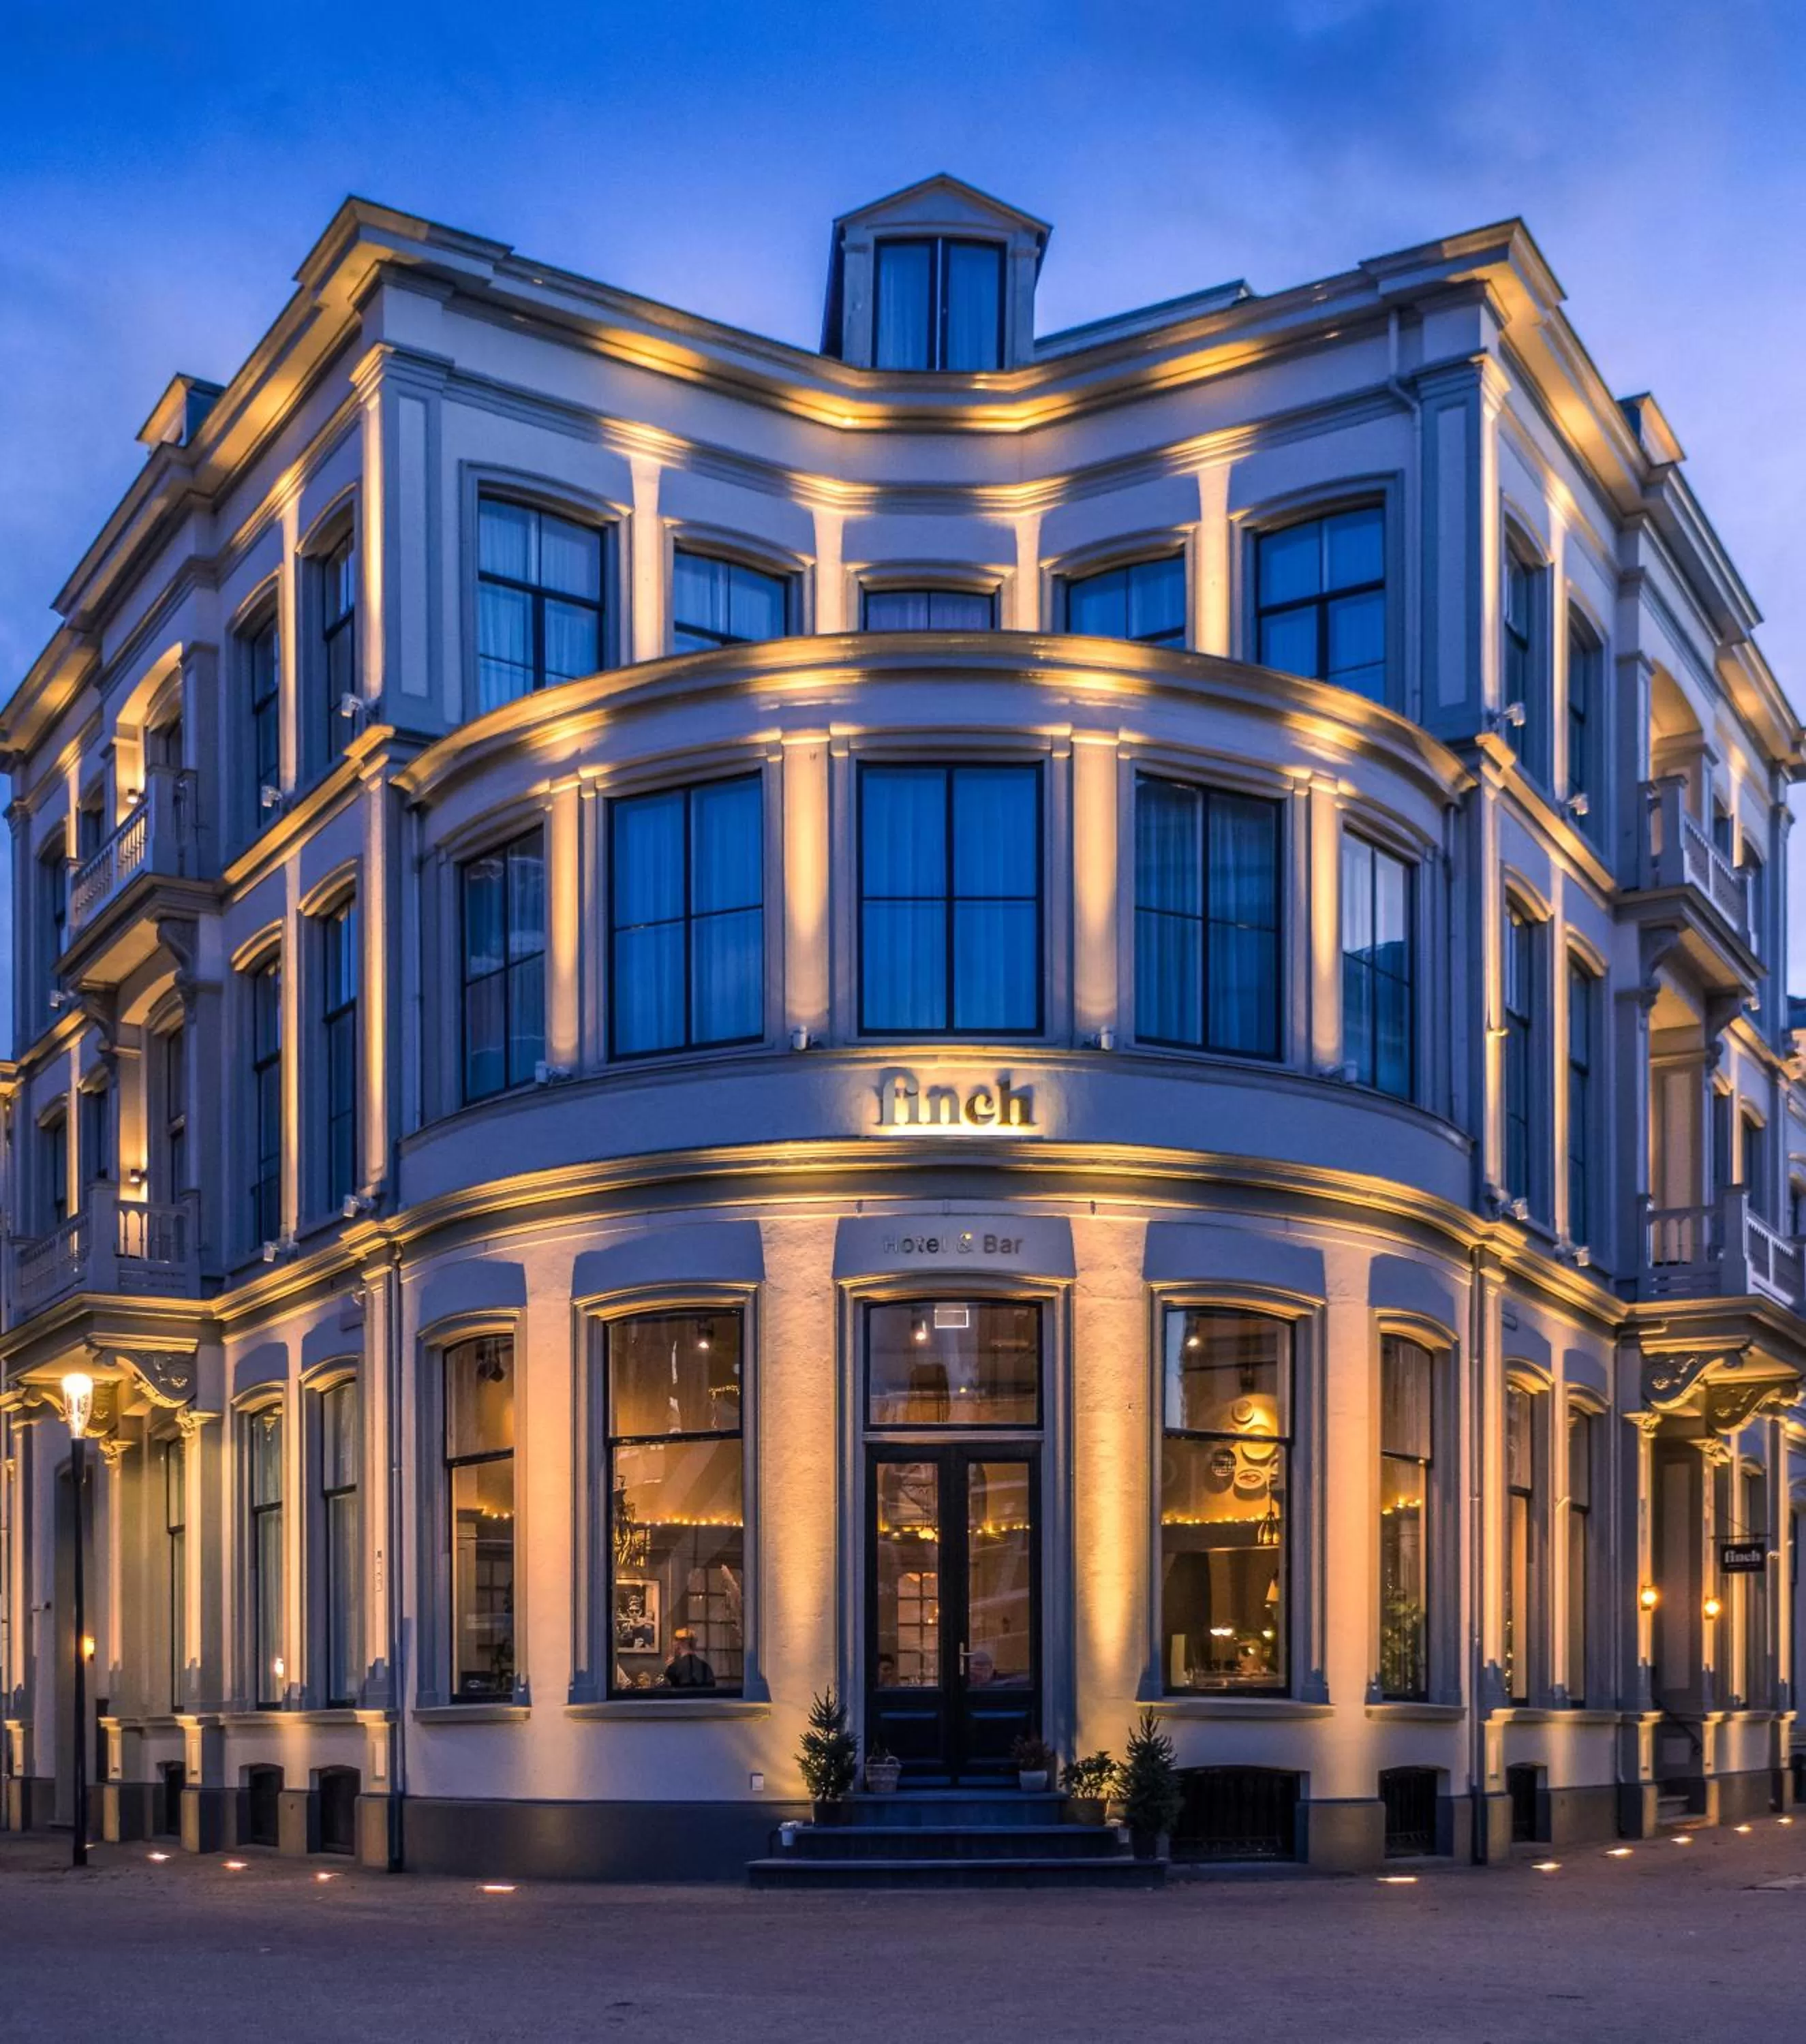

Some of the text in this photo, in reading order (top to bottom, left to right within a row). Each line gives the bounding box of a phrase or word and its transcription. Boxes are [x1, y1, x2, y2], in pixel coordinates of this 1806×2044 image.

[876, 1068, 1037, 1126] finch
[883, 1232, 1024, 1254] Hotel & Bar
[1725, 1550, 1761, 1563] finch
